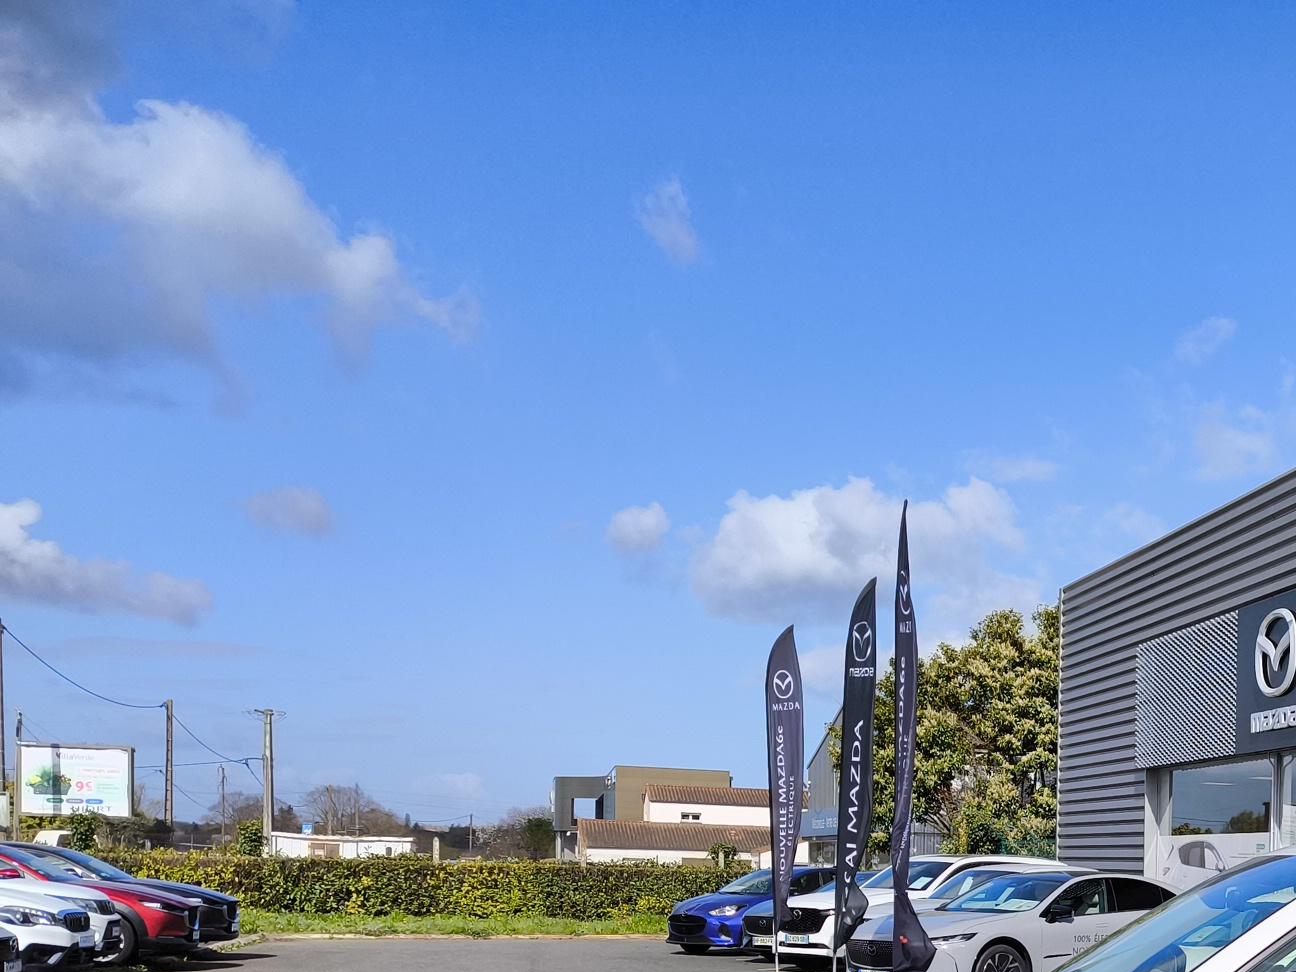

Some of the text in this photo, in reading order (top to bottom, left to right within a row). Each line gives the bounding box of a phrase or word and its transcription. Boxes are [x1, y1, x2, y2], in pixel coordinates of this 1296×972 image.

[849, 667, 874, 677] mazda
[772, 702, 800, 711] MAZDA
[776, 724, 786, 802] MAZDA6e
[848, 720, 864, 833] MAZDA
[1073, 935, 1092, 943] 100%
